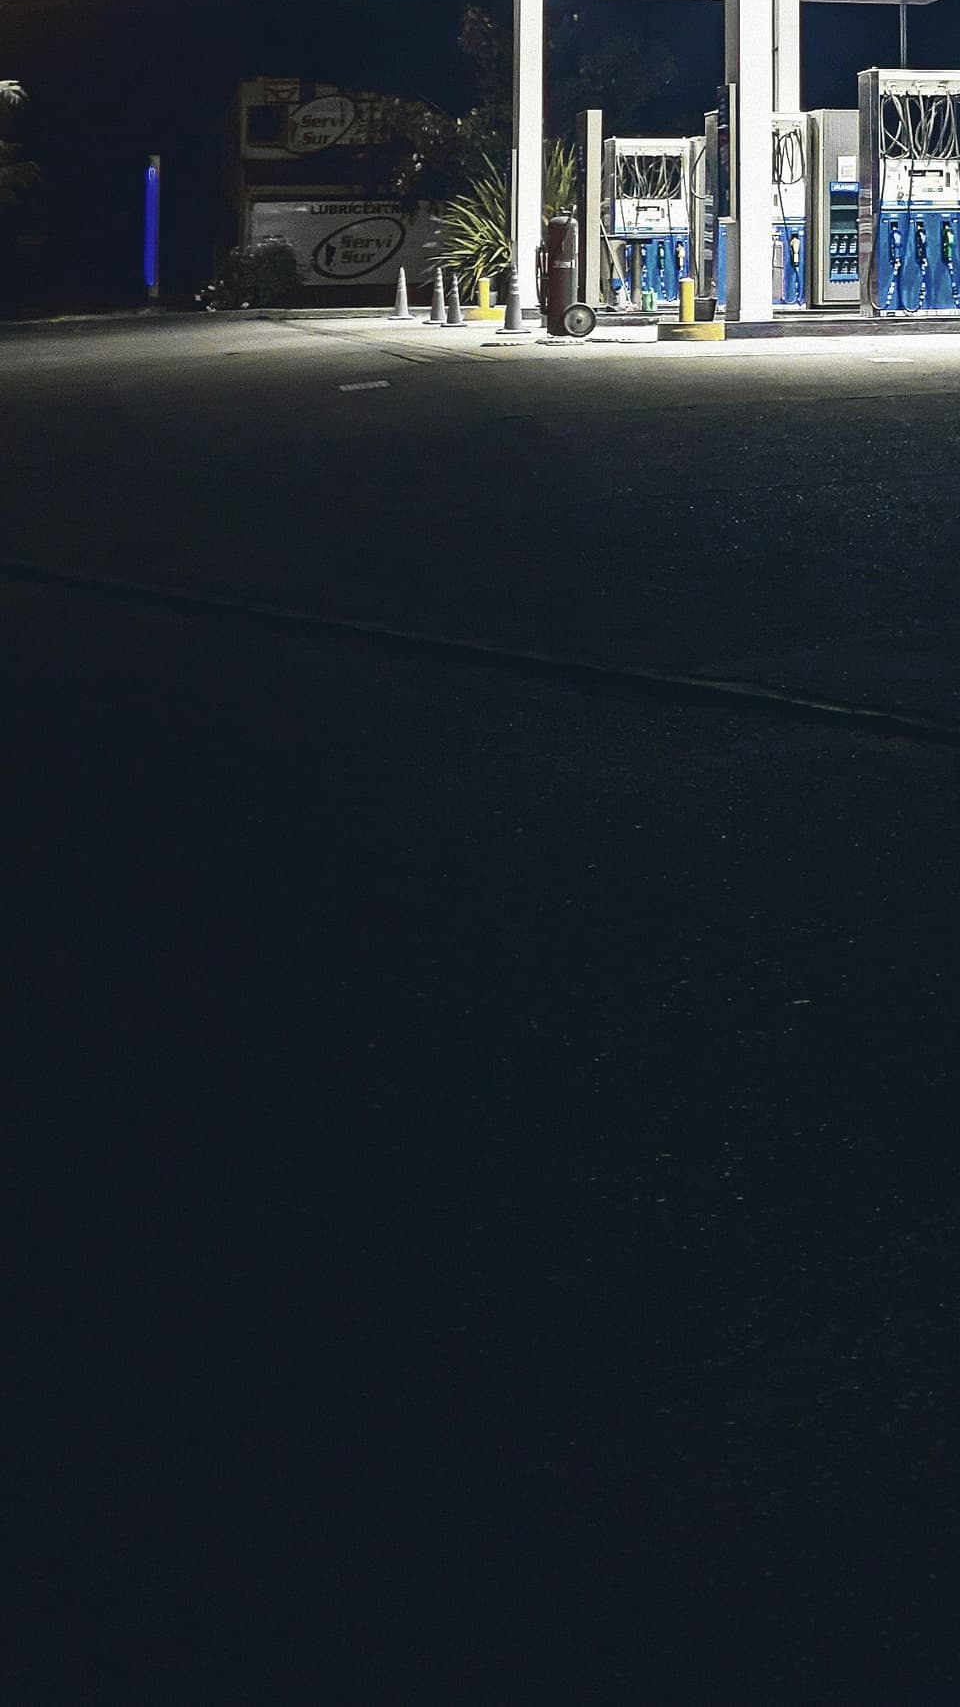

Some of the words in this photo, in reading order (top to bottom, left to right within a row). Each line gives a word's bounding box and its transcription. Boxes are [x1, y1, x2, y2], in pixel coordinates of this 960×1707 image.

[301, 114, 345, 128] Servi
[303, 132, 330, 144] Sur
[311, 204, 402, 215] LUBRICENTR
[340, 234, 393, 247] Servi
[340, 250, 375, 263] Sur
